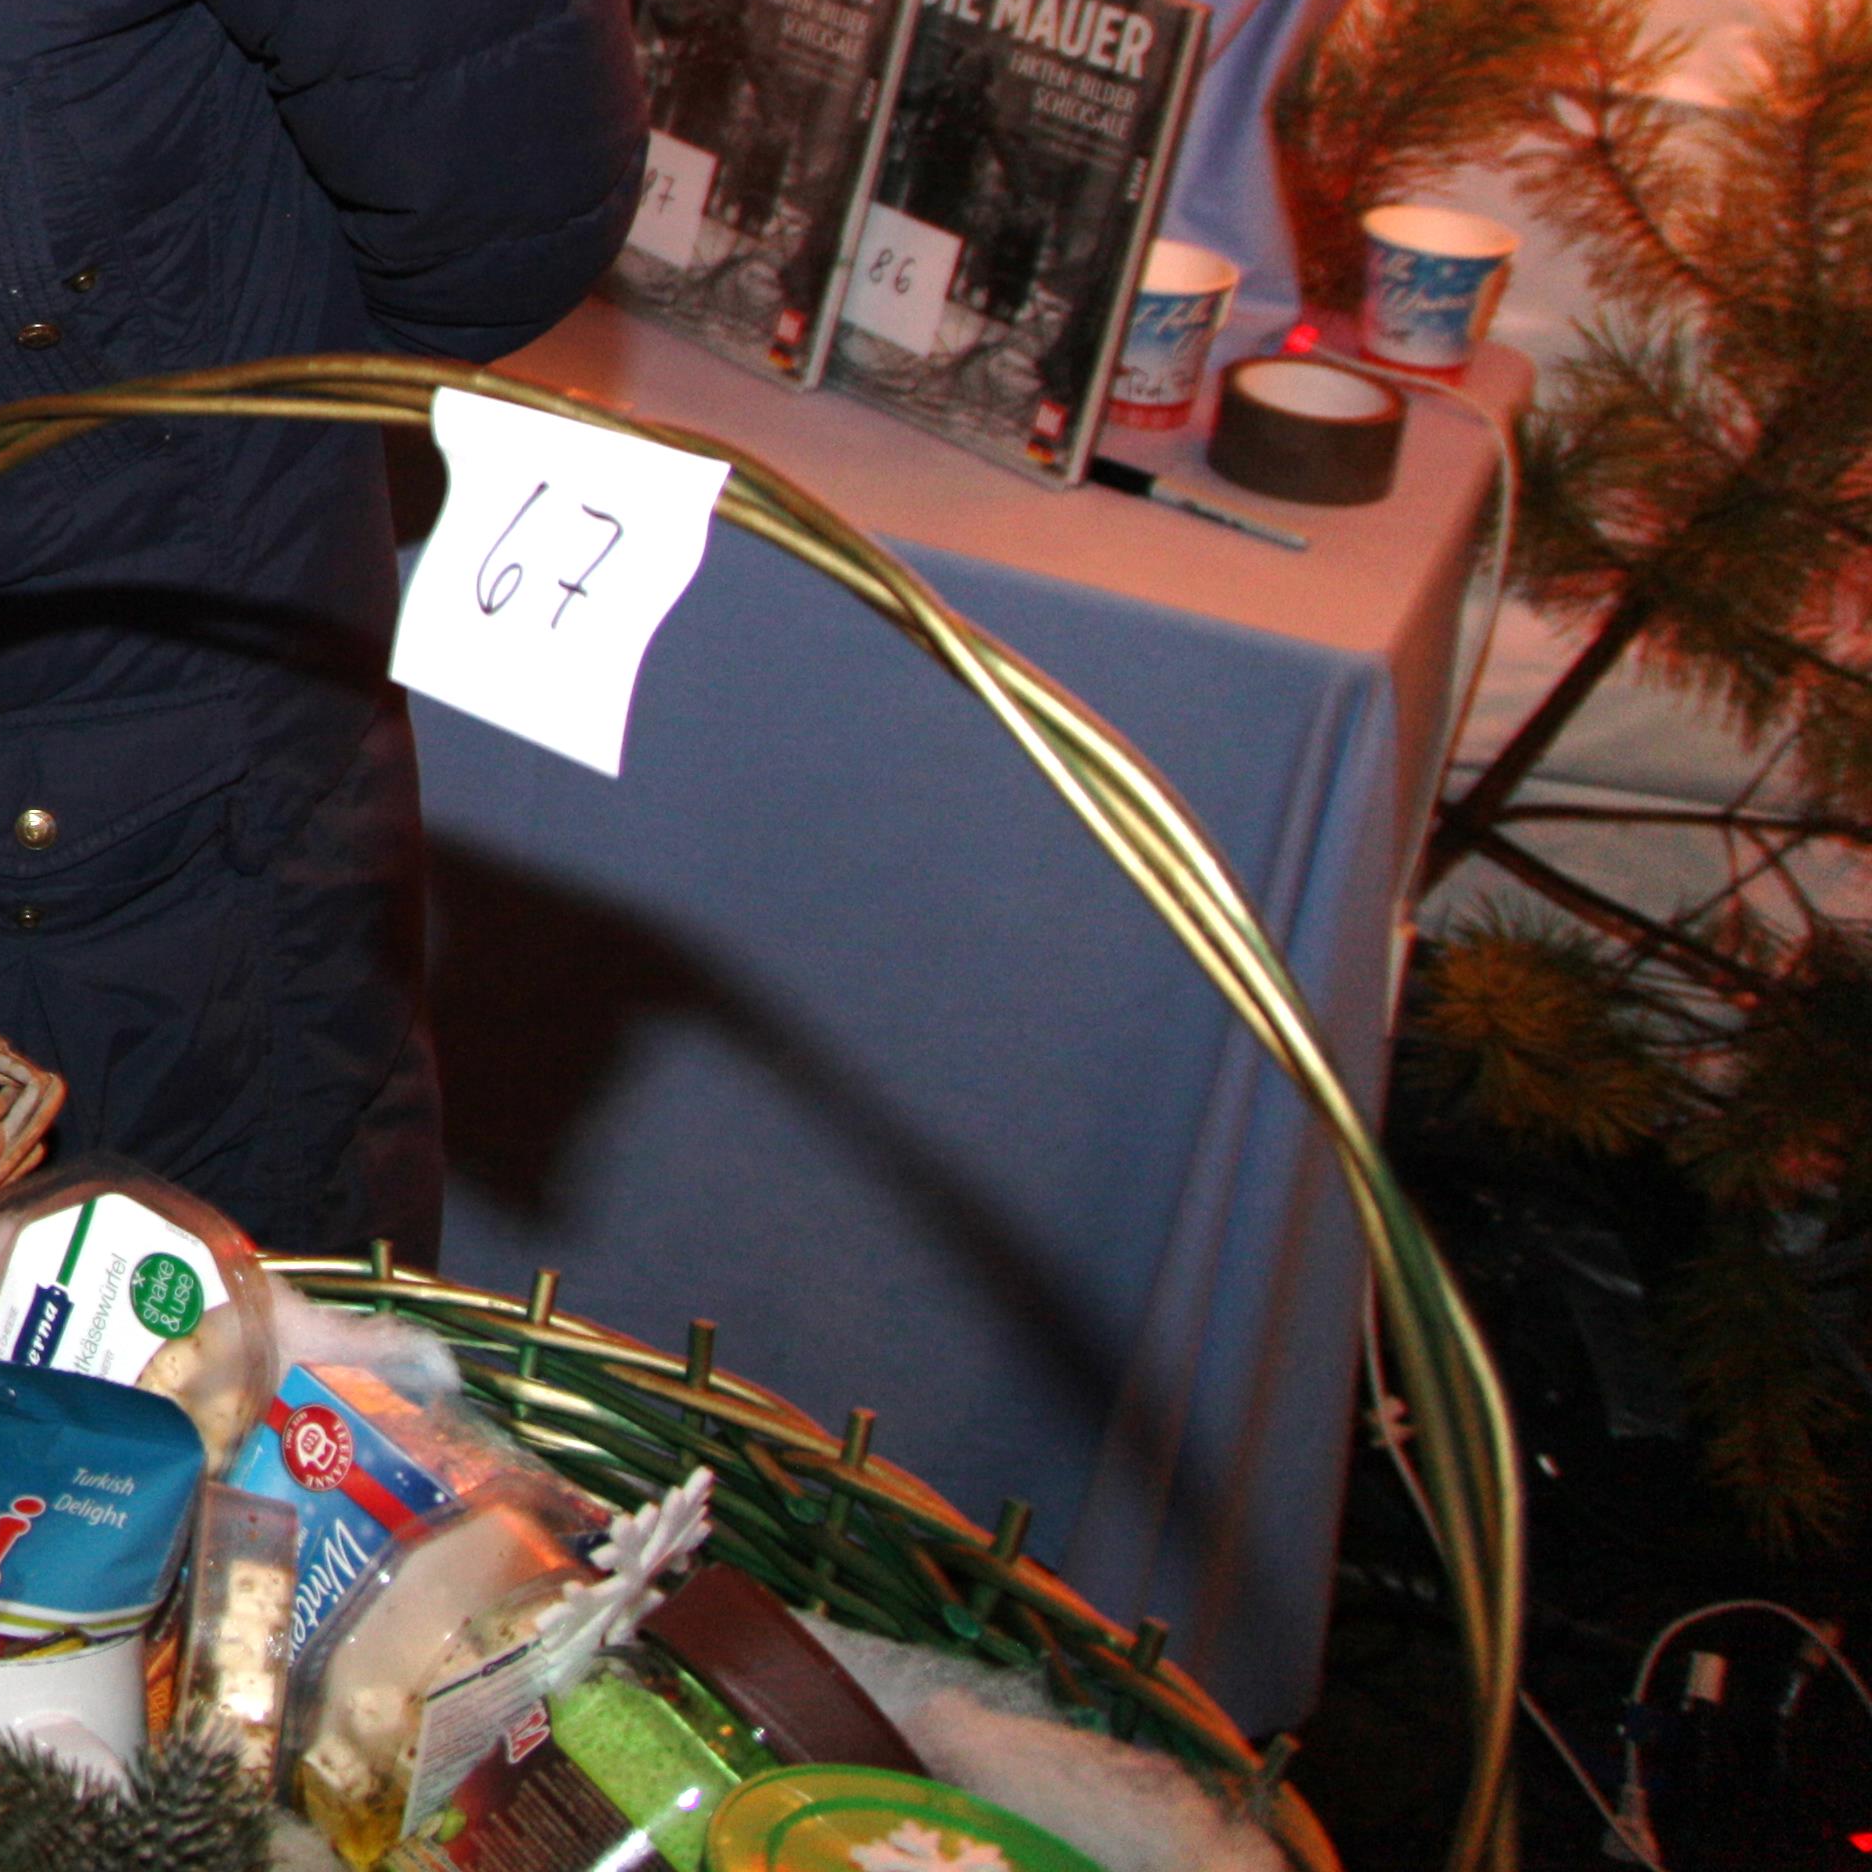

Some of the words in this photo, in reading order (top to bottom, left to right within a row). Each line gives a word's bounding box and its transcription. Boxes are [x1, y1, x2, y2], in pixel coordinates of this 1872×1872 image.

[1078, 72, 1139, 113] BILDER
[868, 247, 918, 295] 86
[477, 482, 623, 630] 67
[143, 1258, 176, 1325] shake
[159, 1312, 181, 1333] &
[170, 1272, 195, 1316] use
[25, 1300, 60, 1368] erna
[71, 1467, 136, 1496] Turkish
[53, 1492, 130, 1531] Delight
